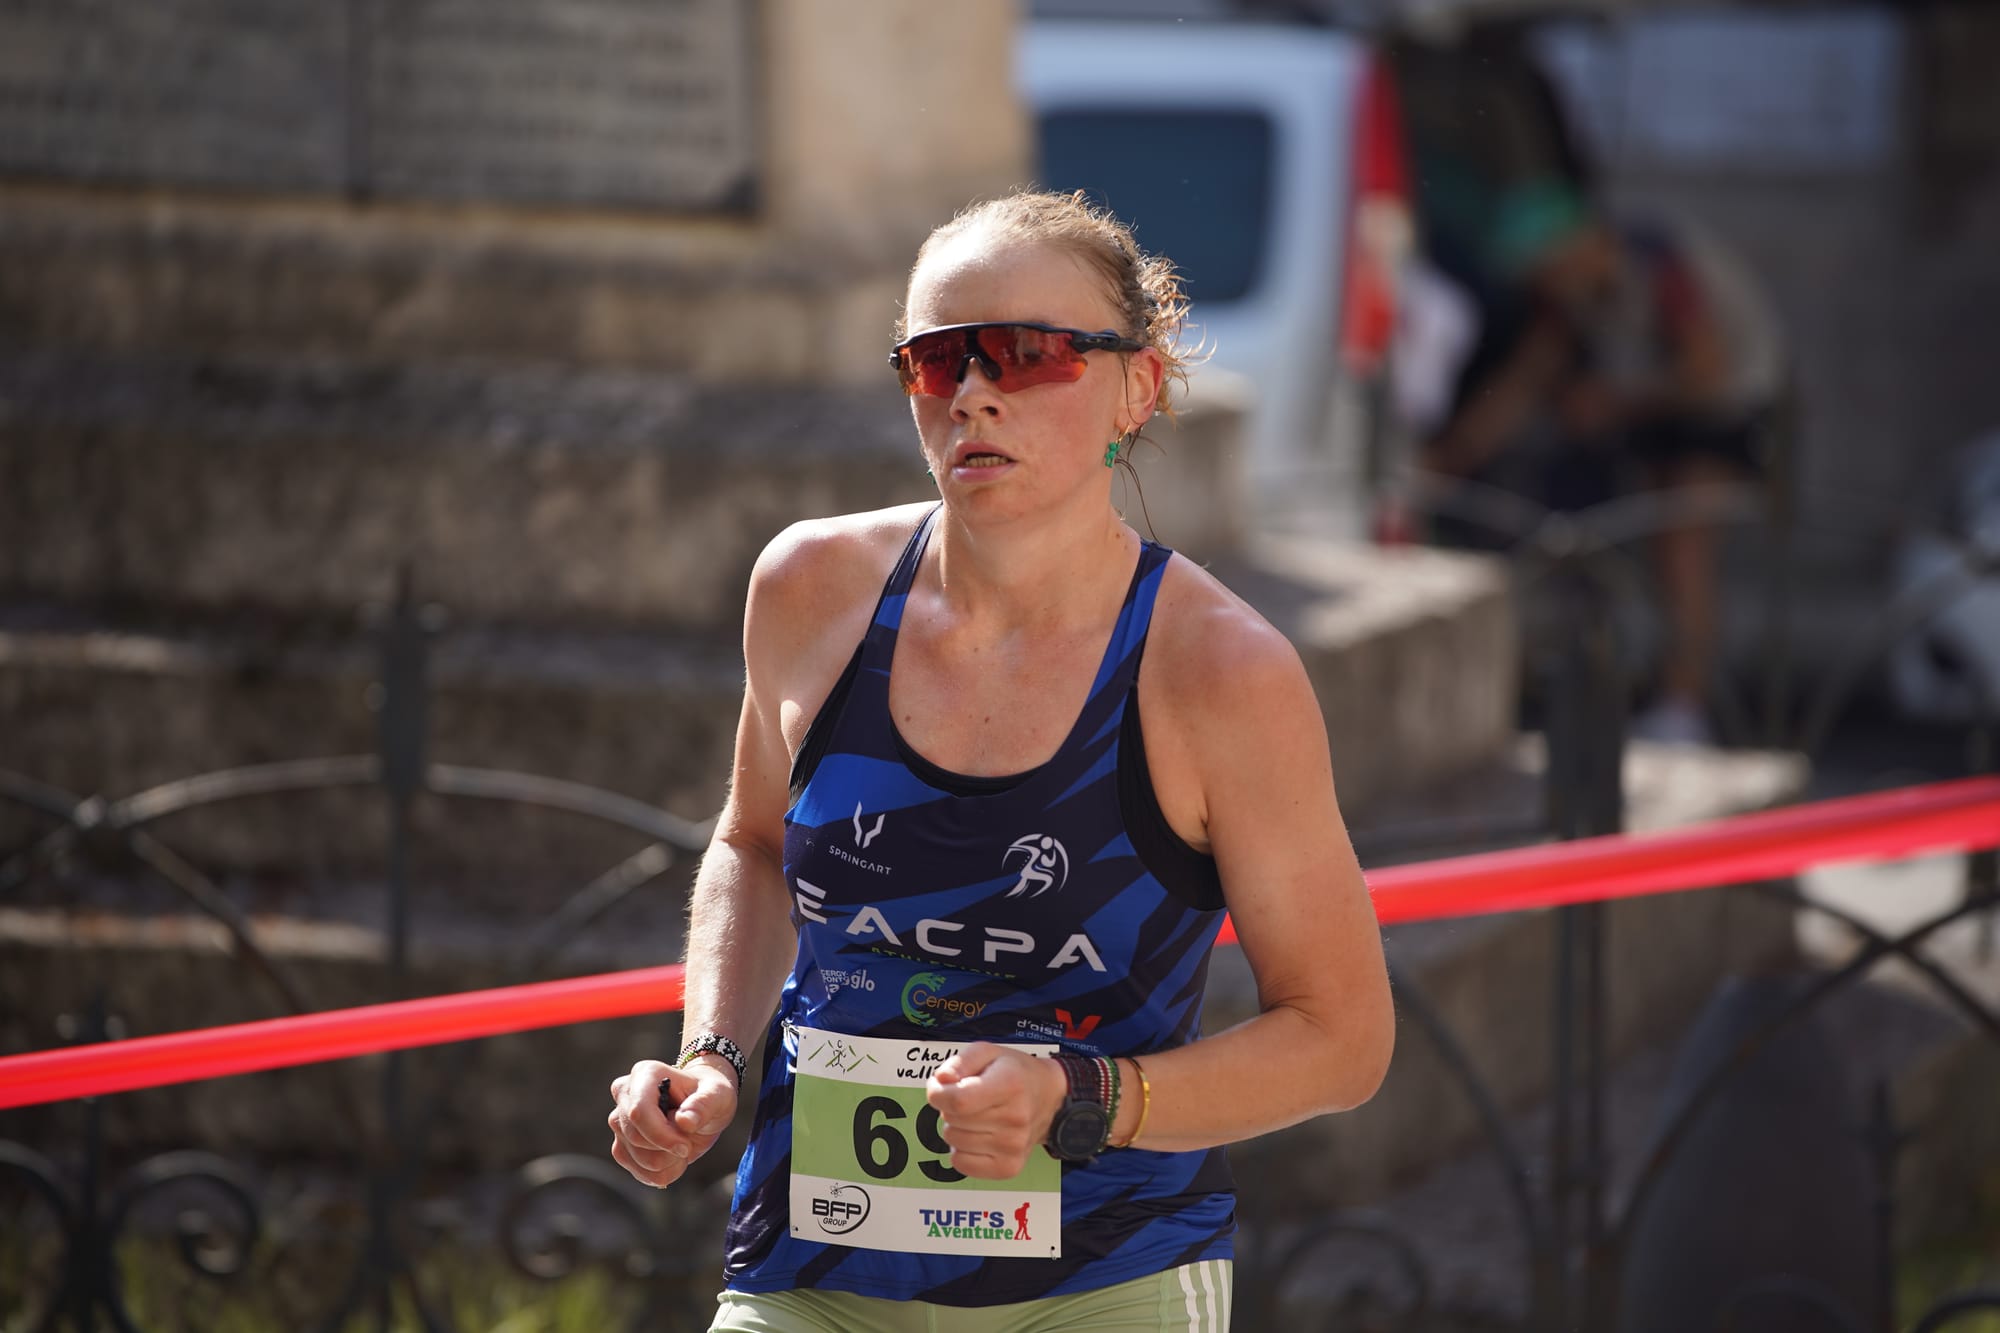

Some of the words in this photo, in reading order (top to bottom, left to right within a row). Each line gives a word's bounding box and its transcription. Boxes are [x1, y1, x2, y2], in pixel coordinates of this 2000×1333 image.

[829, 845, 892, 875] SPRINGART
[796, 877, 1108, 973] EACPA
[1017, 1019, 1063, 1037] d'oise
[906, 1047, 959, 1062] Chall
[897, 1065, 938, 1080] vall
[812, 1198, 862, 1219] BFP
[823, 1216, 848, 1227] GROUP
[919, 1209, 1005, 1228] TUFF'S
[927, 1222, 1014, 1240] Aventure
